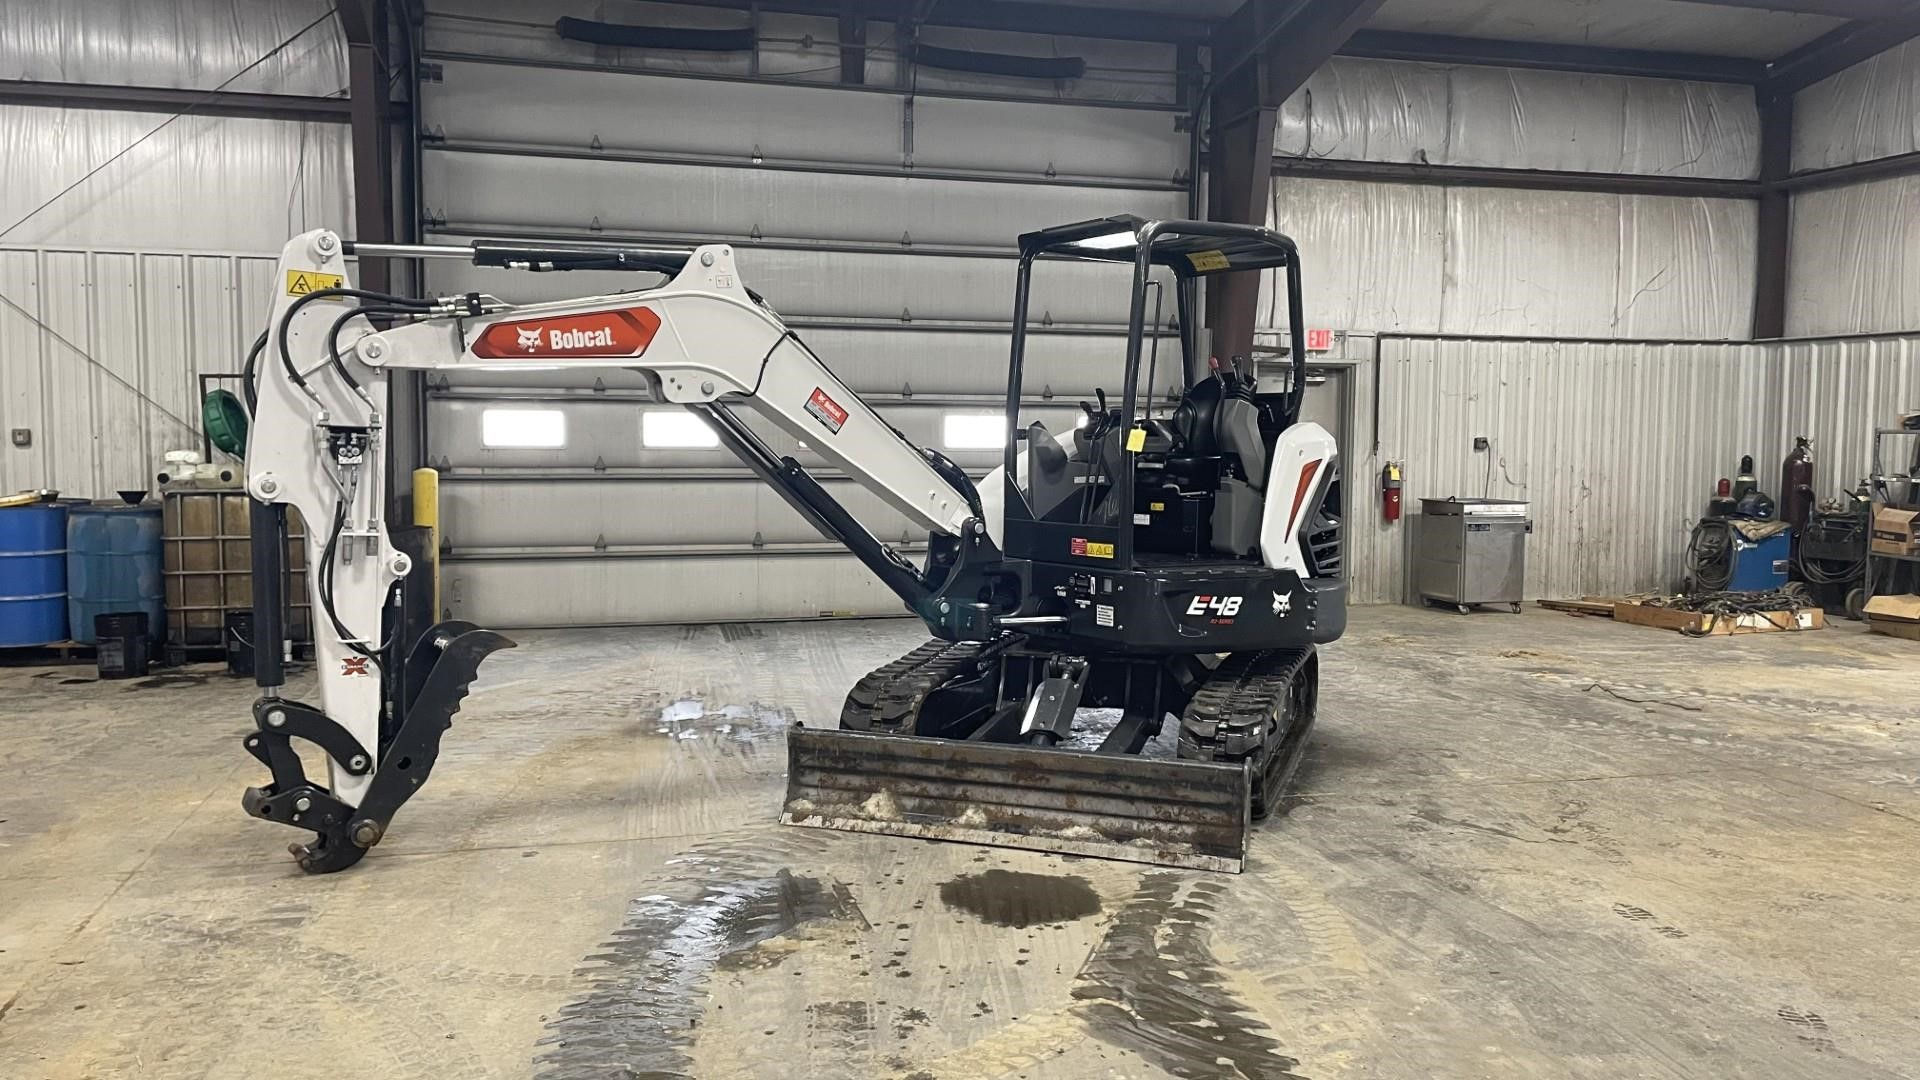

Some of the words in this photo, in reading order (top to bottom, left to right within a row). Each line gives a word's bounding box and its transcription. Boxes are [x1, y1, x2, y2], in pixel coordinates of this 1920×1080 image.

[550, 326, 613, 350] Bobcat
[1309, 330, 1328, 348] EXIT
[1186, 595, 1243, 616] E48
